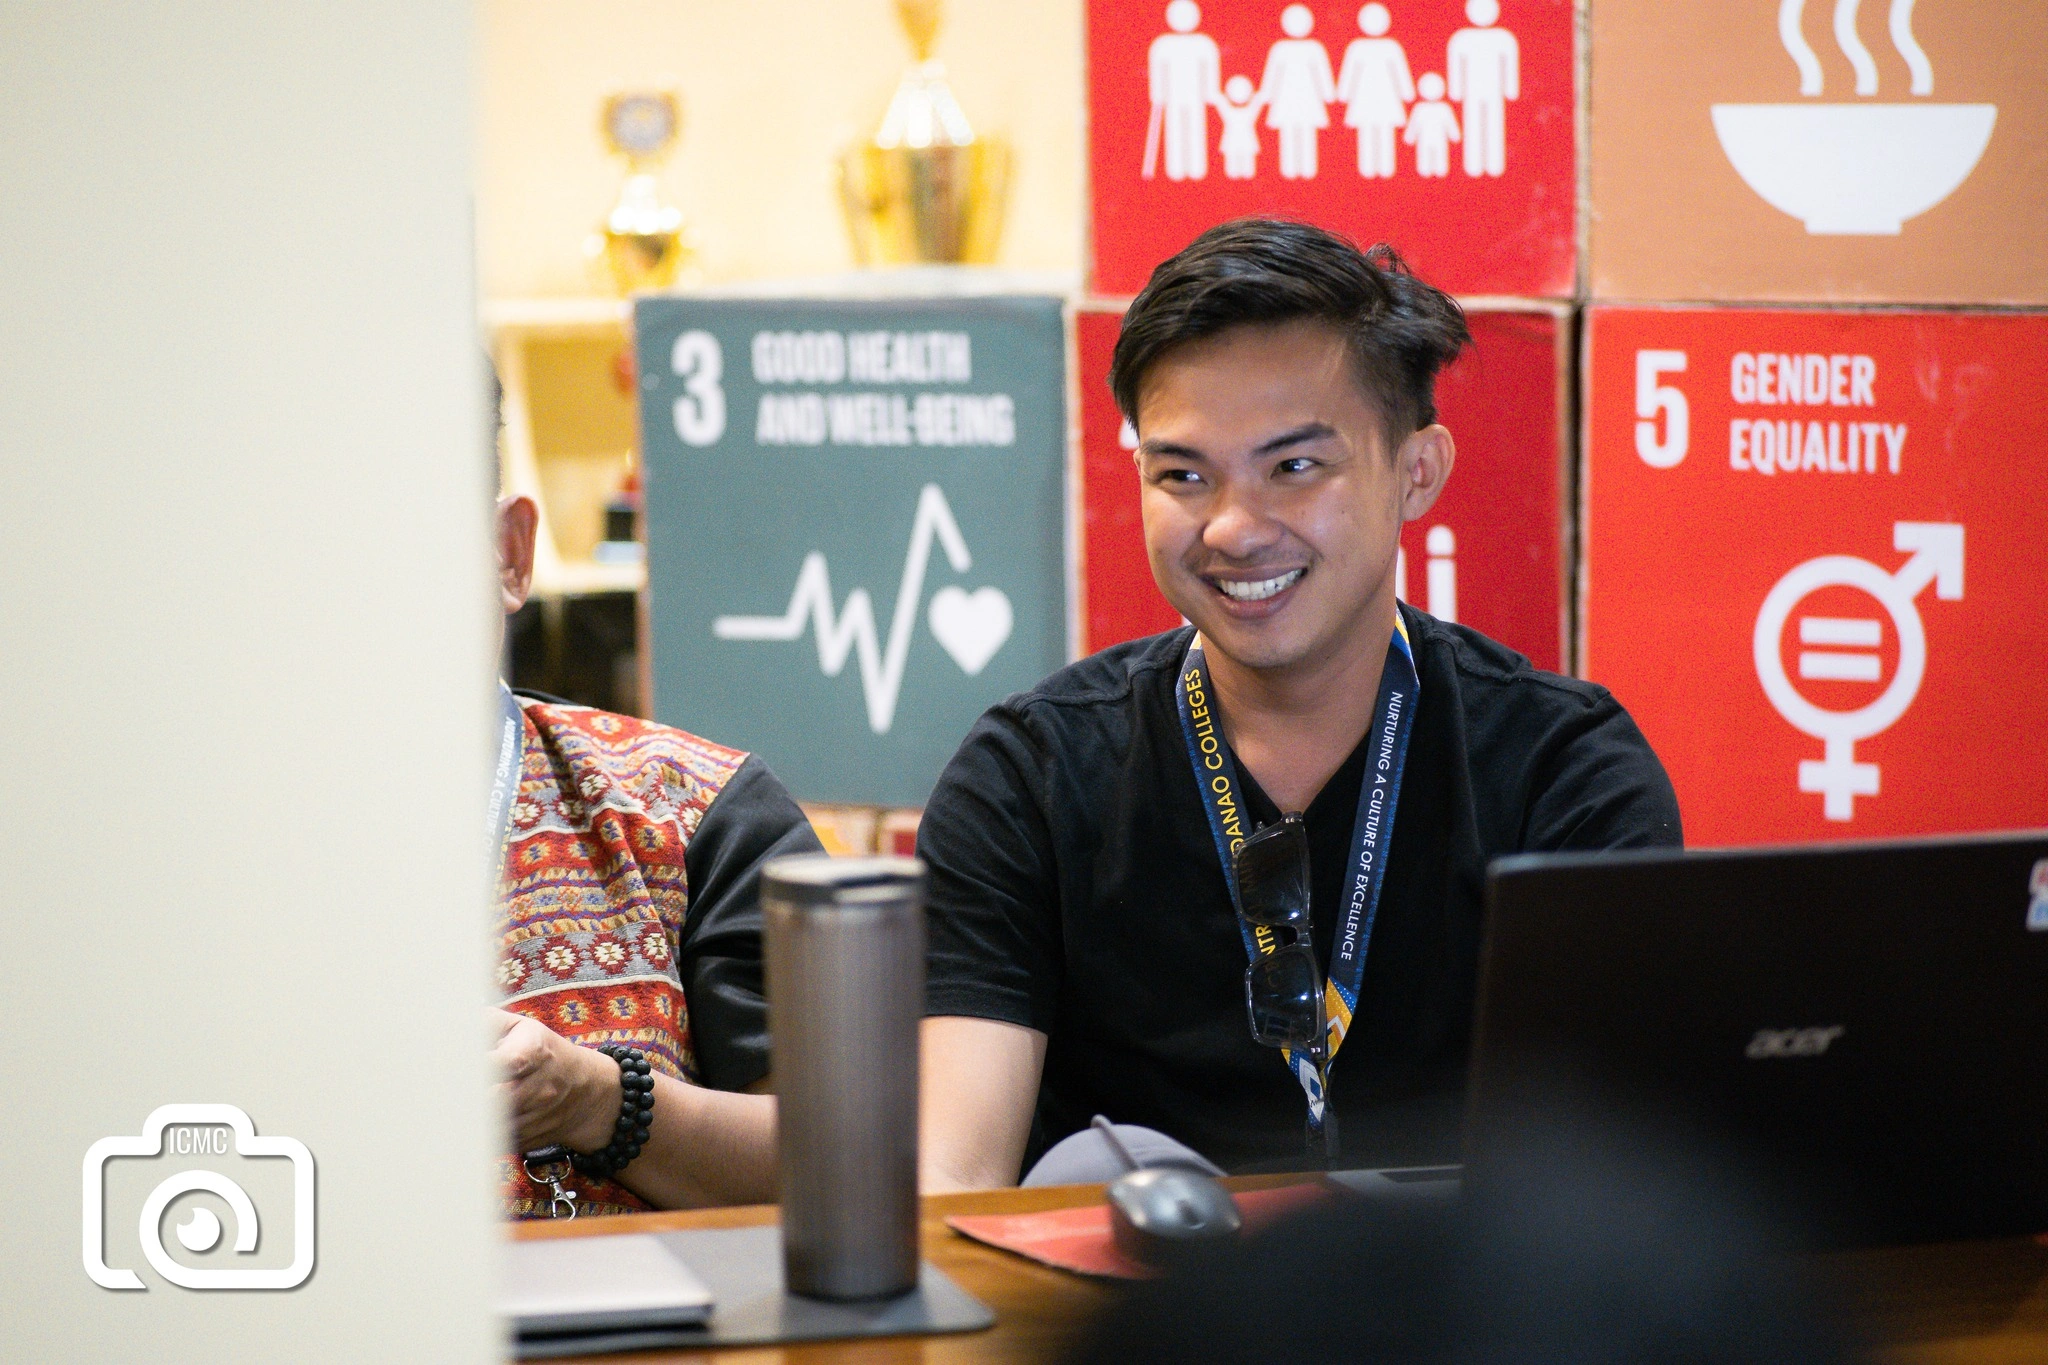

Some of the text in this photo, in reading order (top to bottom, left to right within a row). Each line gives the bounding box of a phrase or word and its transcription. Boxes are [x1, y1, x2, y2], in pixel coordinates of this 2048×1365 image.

[671, 330, 727, 447] 3
[751, 330, 972, 384] GOOD HEALTH
[1730, 351, 1876, 407] GENDER
[755, 393, 1017, 447] AND WELL-BEING
[1634, 349, 1689, 469] 5
[1729, 418, 1908, 476] EQUALITY
[495, 715, 516, 779] NURTURING
[1184, 668, 1223, 770] COLLEGES
[1340, 691, 1404, 961] NURTURING A CULTURE OF EXCELLENCE
